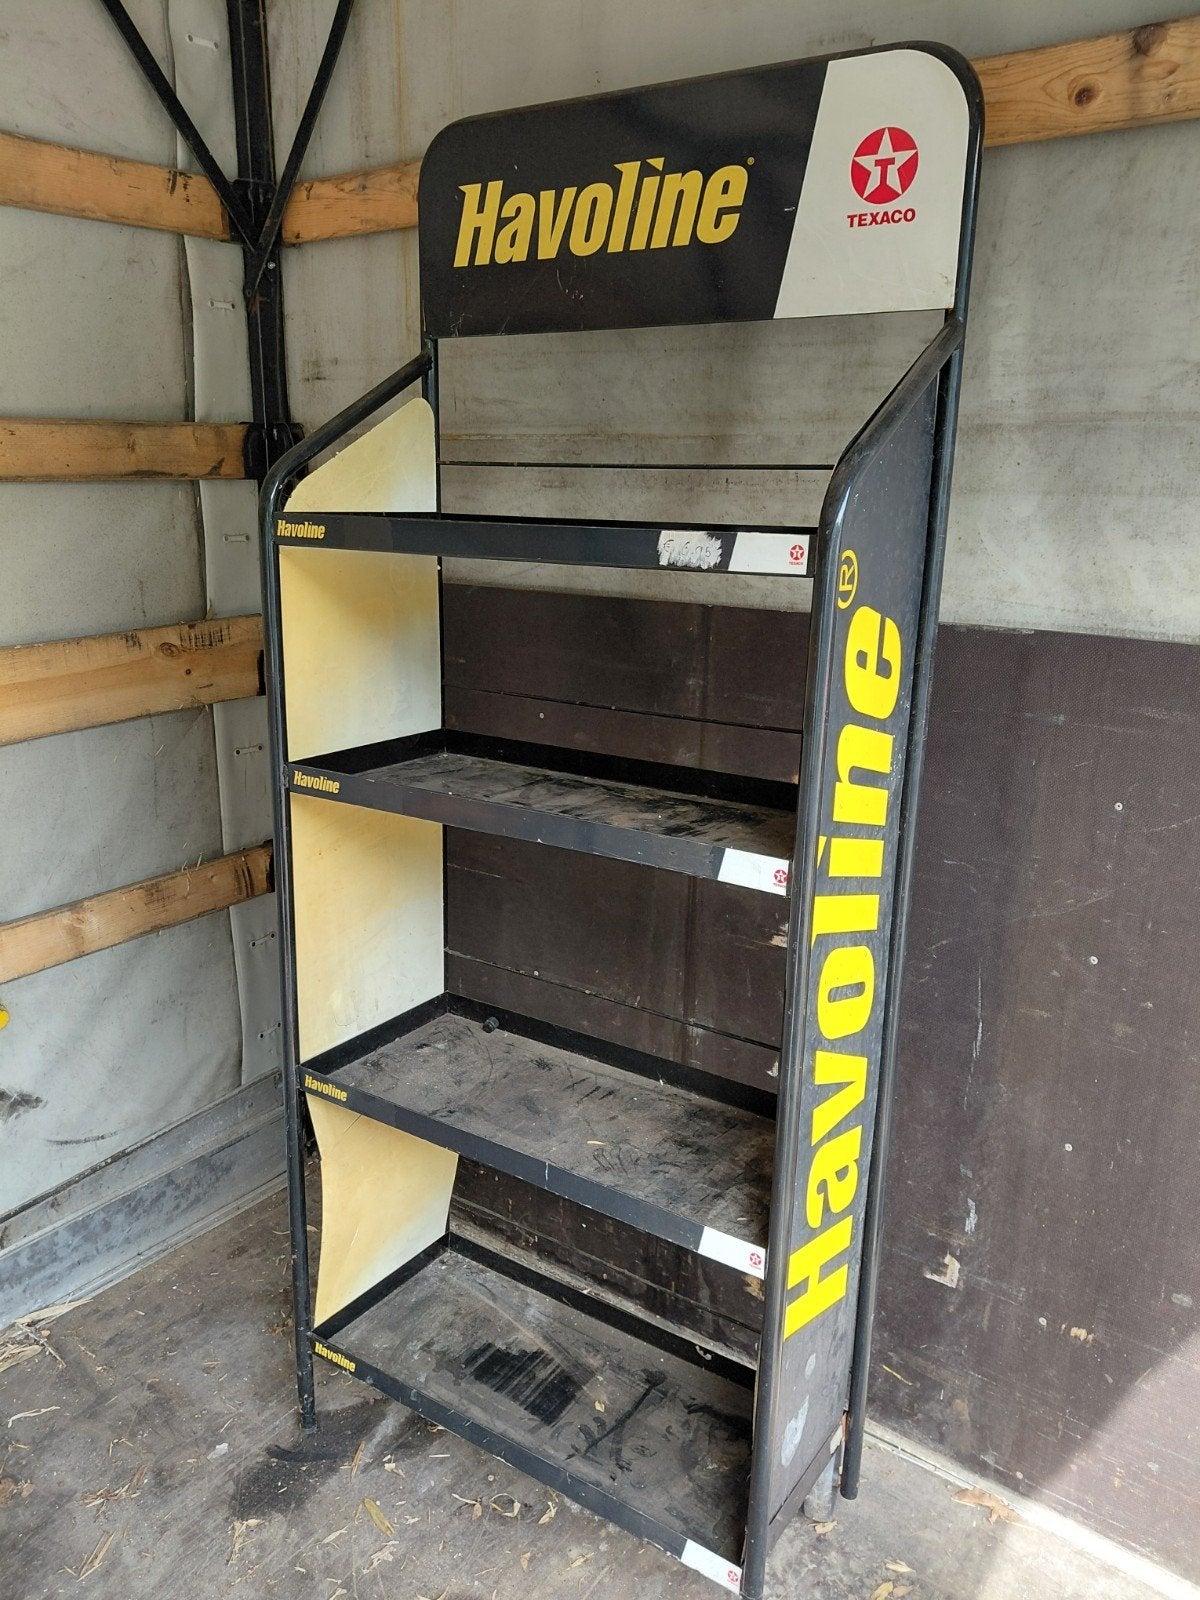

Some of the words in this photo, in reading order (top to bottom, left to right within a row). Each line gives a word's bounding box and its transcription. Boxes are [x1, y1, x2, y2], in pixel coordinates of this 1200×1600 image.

[847, 208, 916, 228] TEXACO
[276, 519, 326, 540] Havoline
[293, 770, 340, 794] Havoline
[304, 1074, 348, 1102] Havoline
[314, 1341, 356, 1373] Havoline
